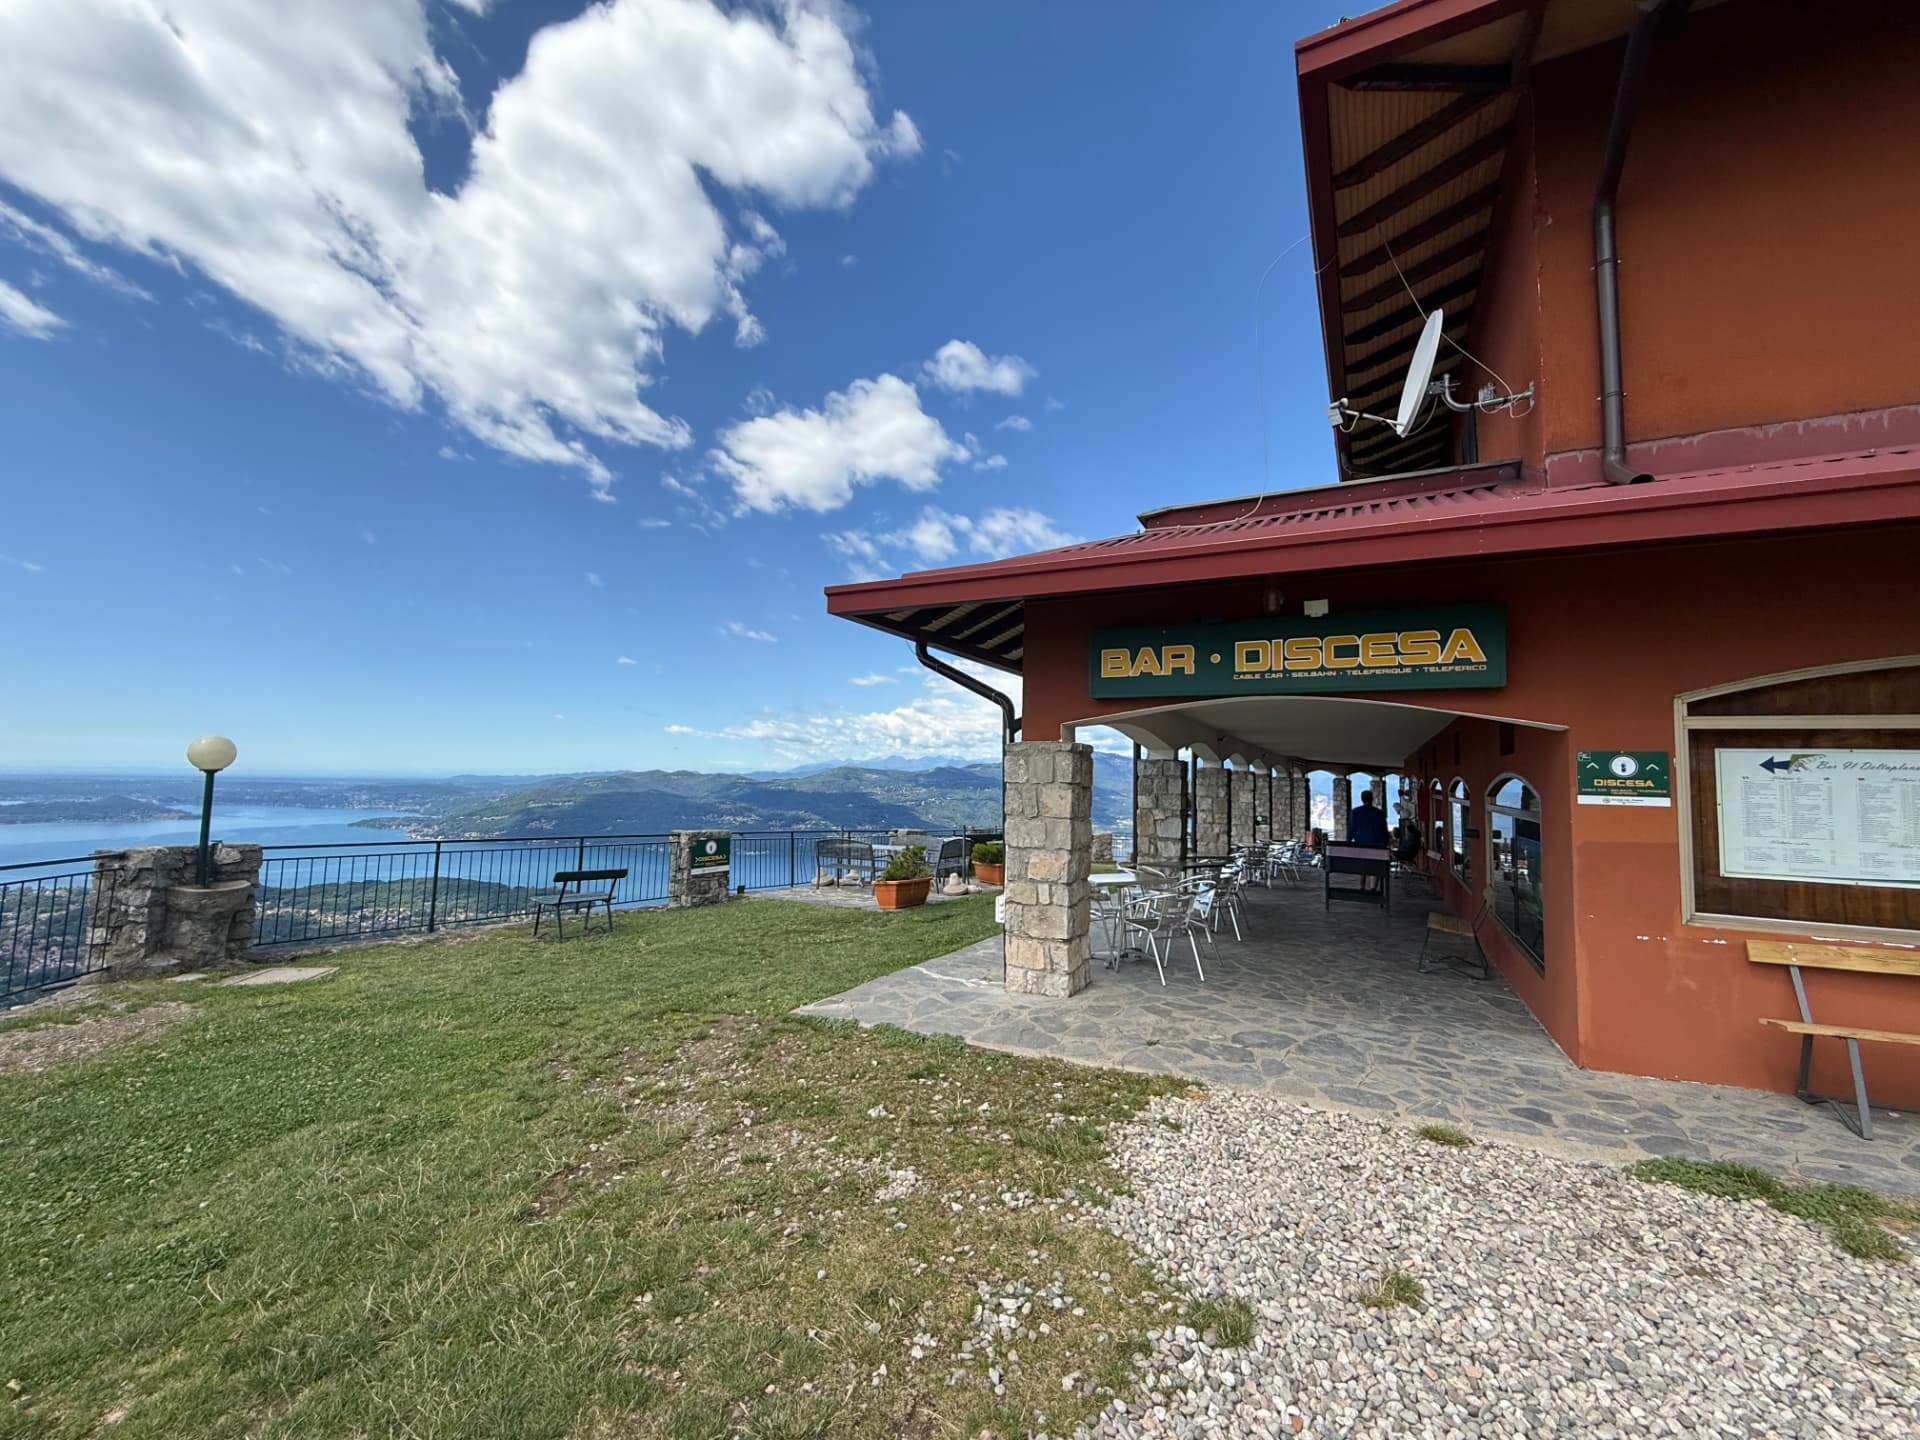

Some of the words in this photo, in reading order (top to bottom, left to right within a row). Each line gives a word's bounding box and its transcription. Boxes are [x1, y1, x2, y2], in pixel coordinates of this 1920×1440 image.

[1101, 645, 1195, 678] BAR
[1234, 628, 1488, 672] DISCESA
[1291, 670, 1337, 678] SEILBAHN
[1346, 667, 1412, 676] TELEFERIQUE
[1423, 664, 1487, 673] TELEFERICO
[1594, 779, 1655, 787] DISCESA
